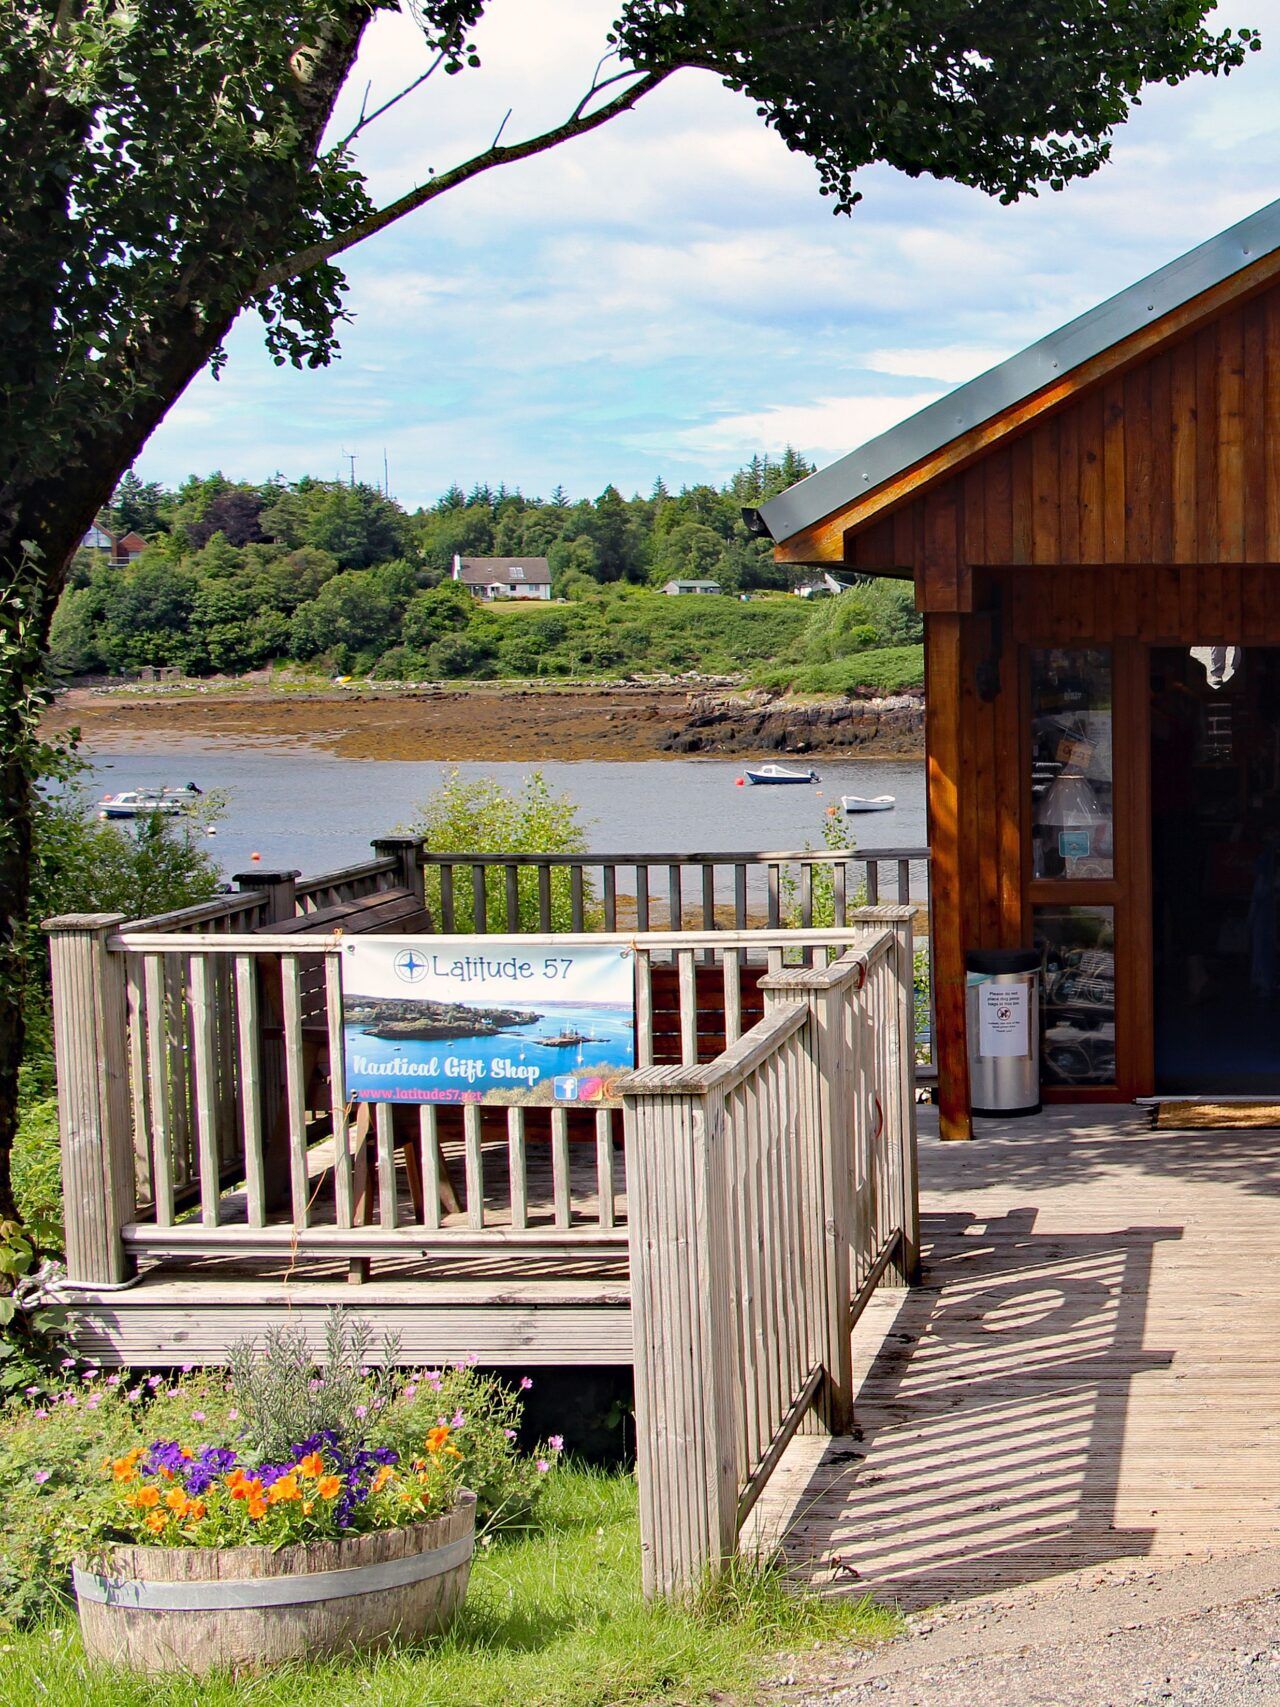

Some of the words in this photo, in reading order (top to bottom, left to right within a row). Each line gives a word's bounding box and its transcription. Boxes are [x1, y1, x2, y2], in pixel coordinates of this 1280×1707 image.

[433, 955, 535, 981] Latitude
[542, 958, 573, 979] 57
[352, 1055, 440, 1077] Nautical
[444, 1056, 486, 1083] Gift
[490, 1057, 540, 1086] Shop
[359, 1088, 483, 1101] www.latitude57.net
